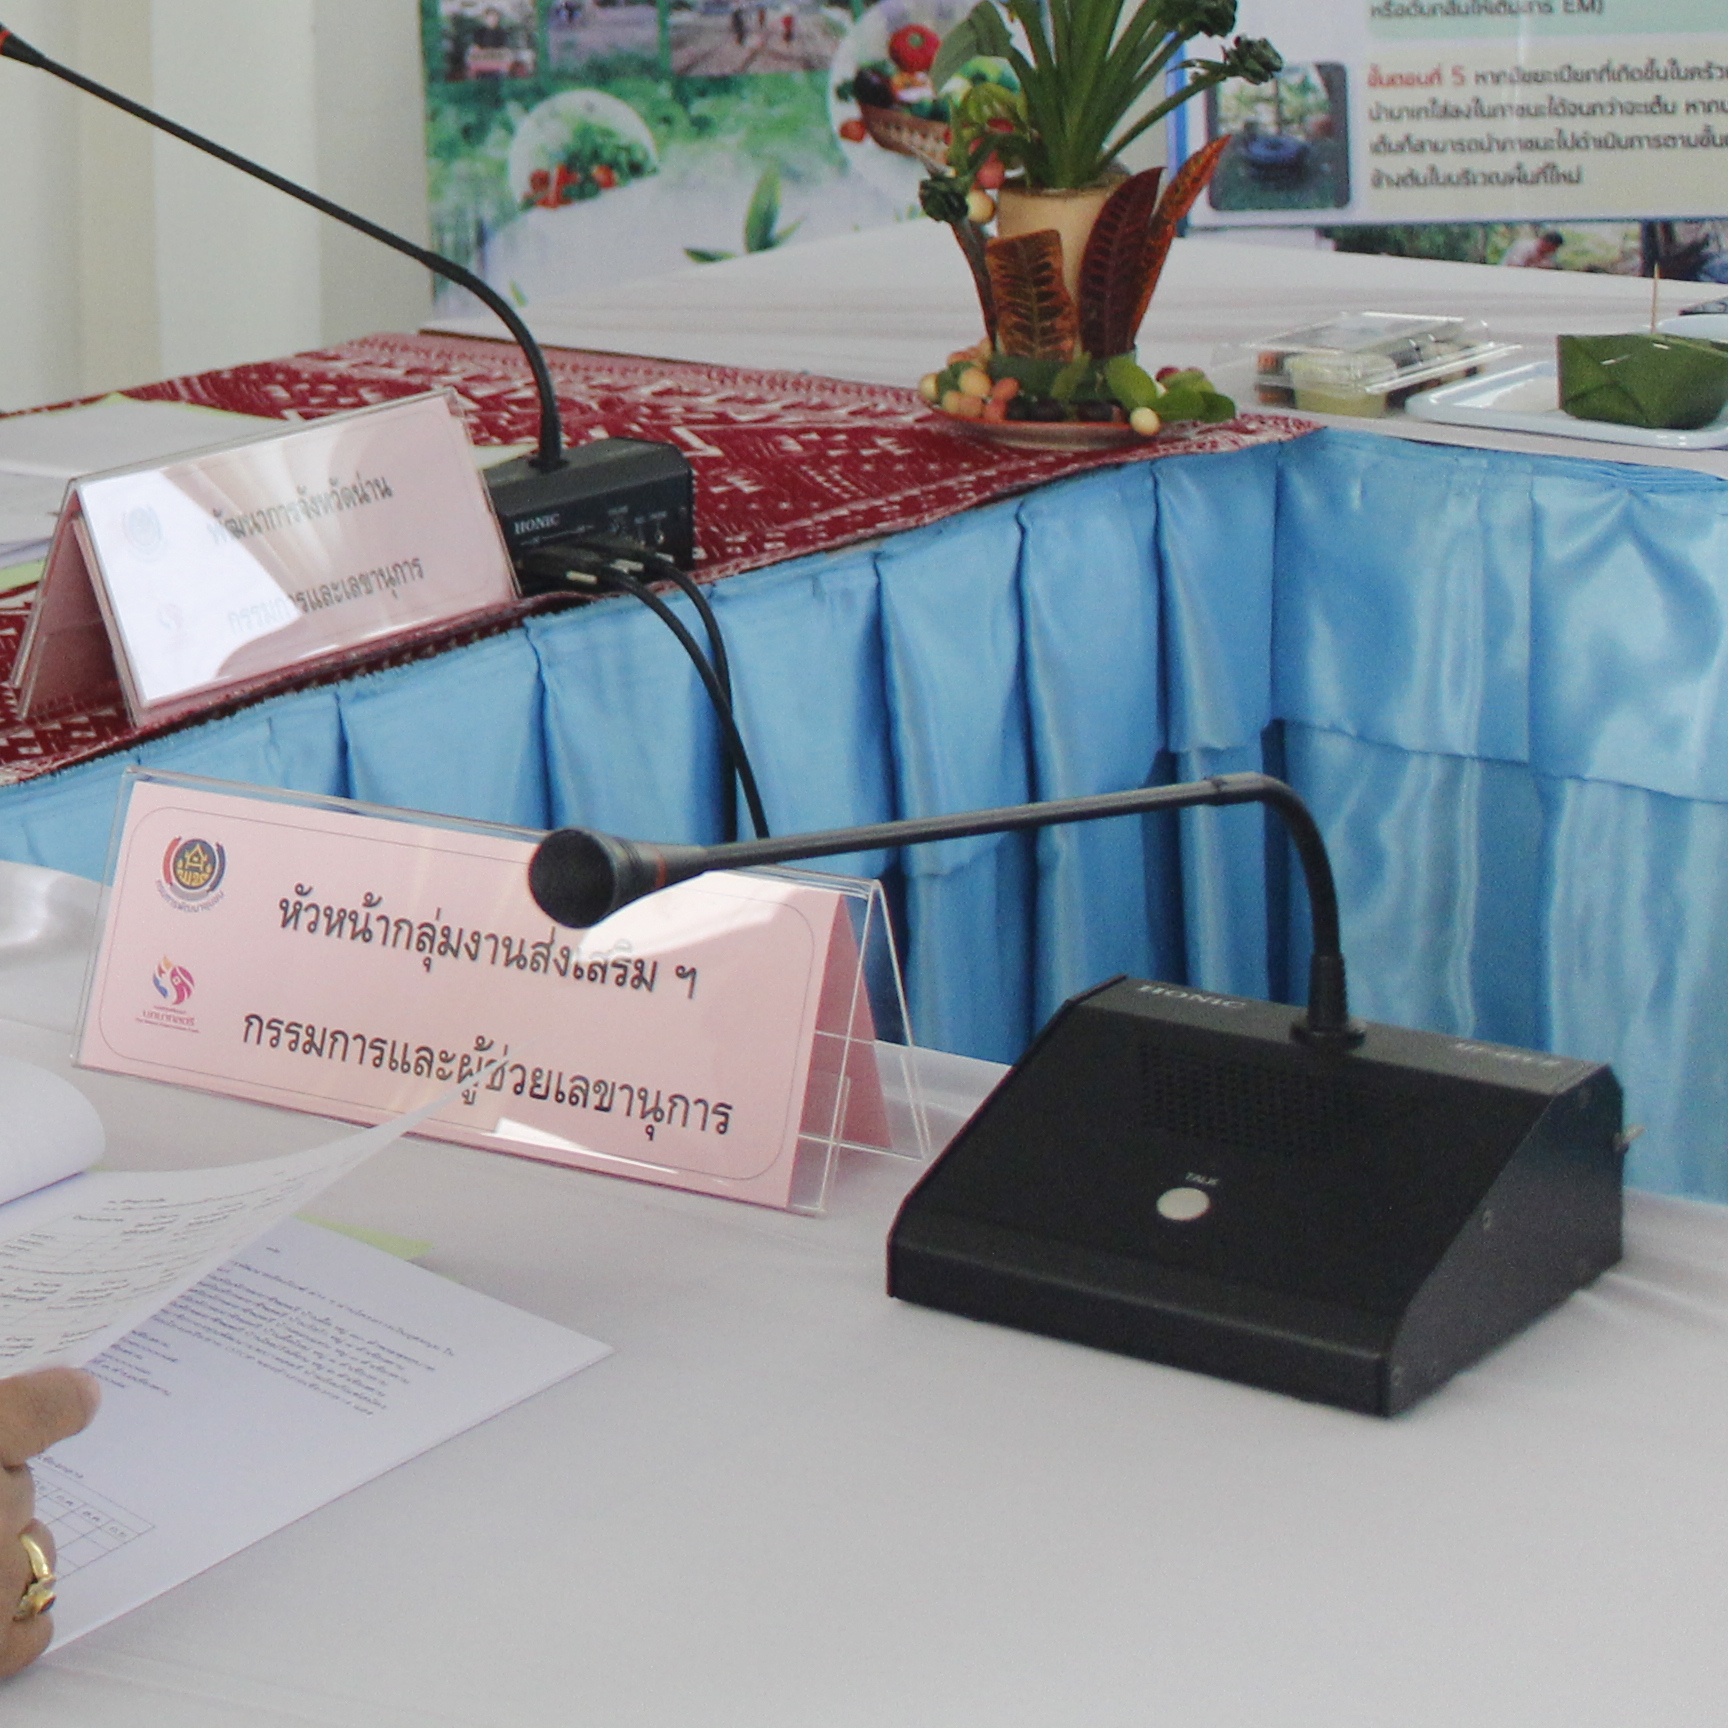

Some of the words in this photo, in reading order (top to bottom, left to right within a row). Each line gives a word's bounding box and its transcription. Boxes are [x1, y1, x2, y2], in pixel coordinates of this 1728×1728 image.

[278, 880, 657, 994] หัวหน้ากลุ่มงานส่งเสริม
[242, 1008, 732, 1140] กรรมการและผู้ช่วยเลขานุการ
